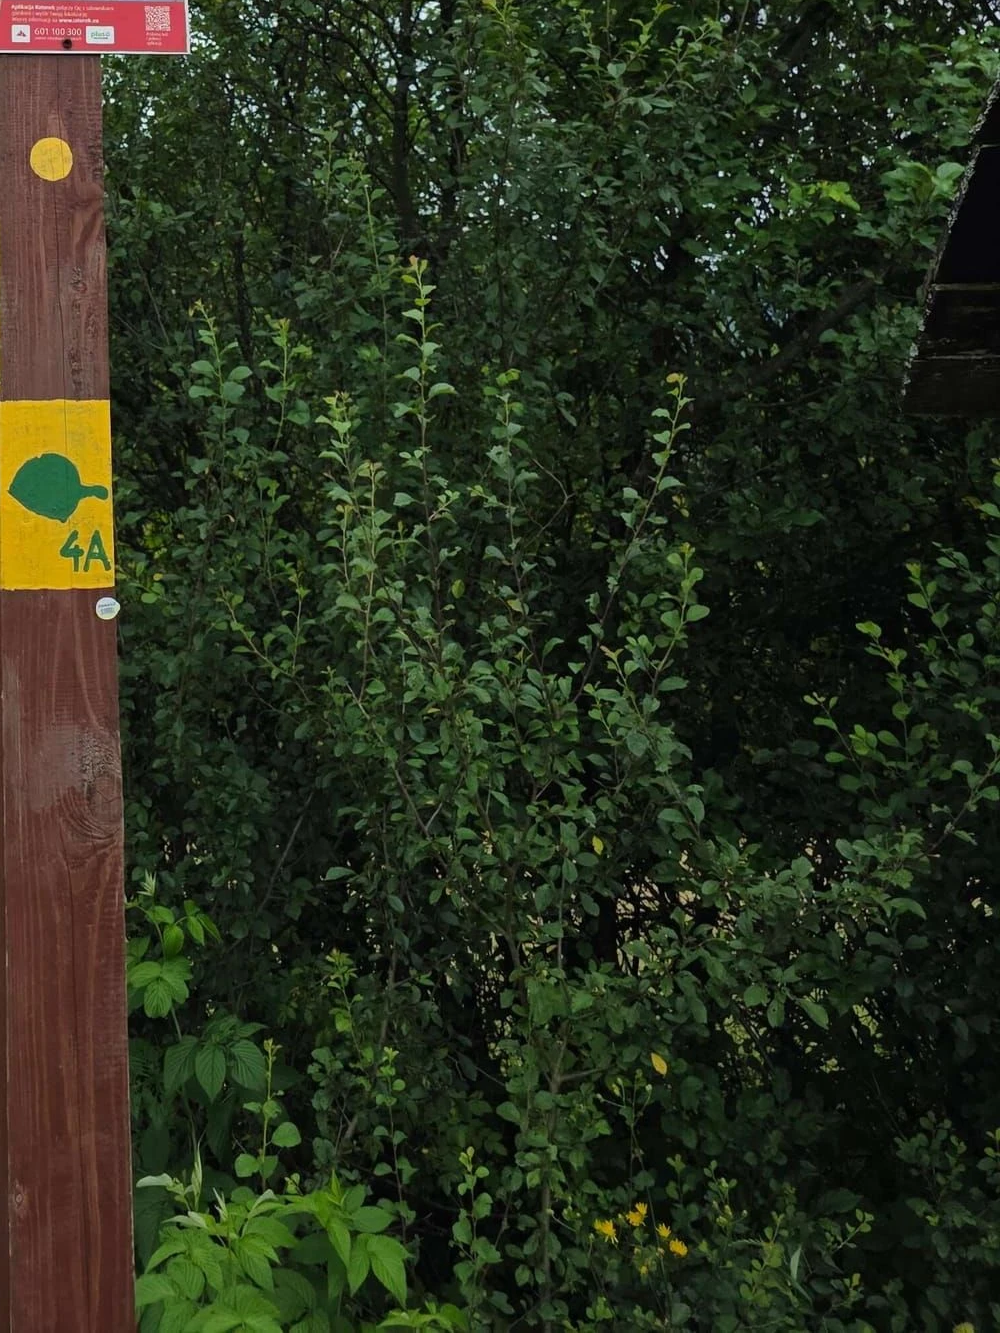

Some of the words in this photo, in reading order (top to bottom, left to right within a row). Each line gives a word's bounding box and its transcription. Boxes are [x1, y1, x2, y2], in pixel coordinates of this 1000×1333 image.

[34, 27, 49, 35] 601
[67, 28, 82, 36] 300
[58, 529, 111, 573] 4A
